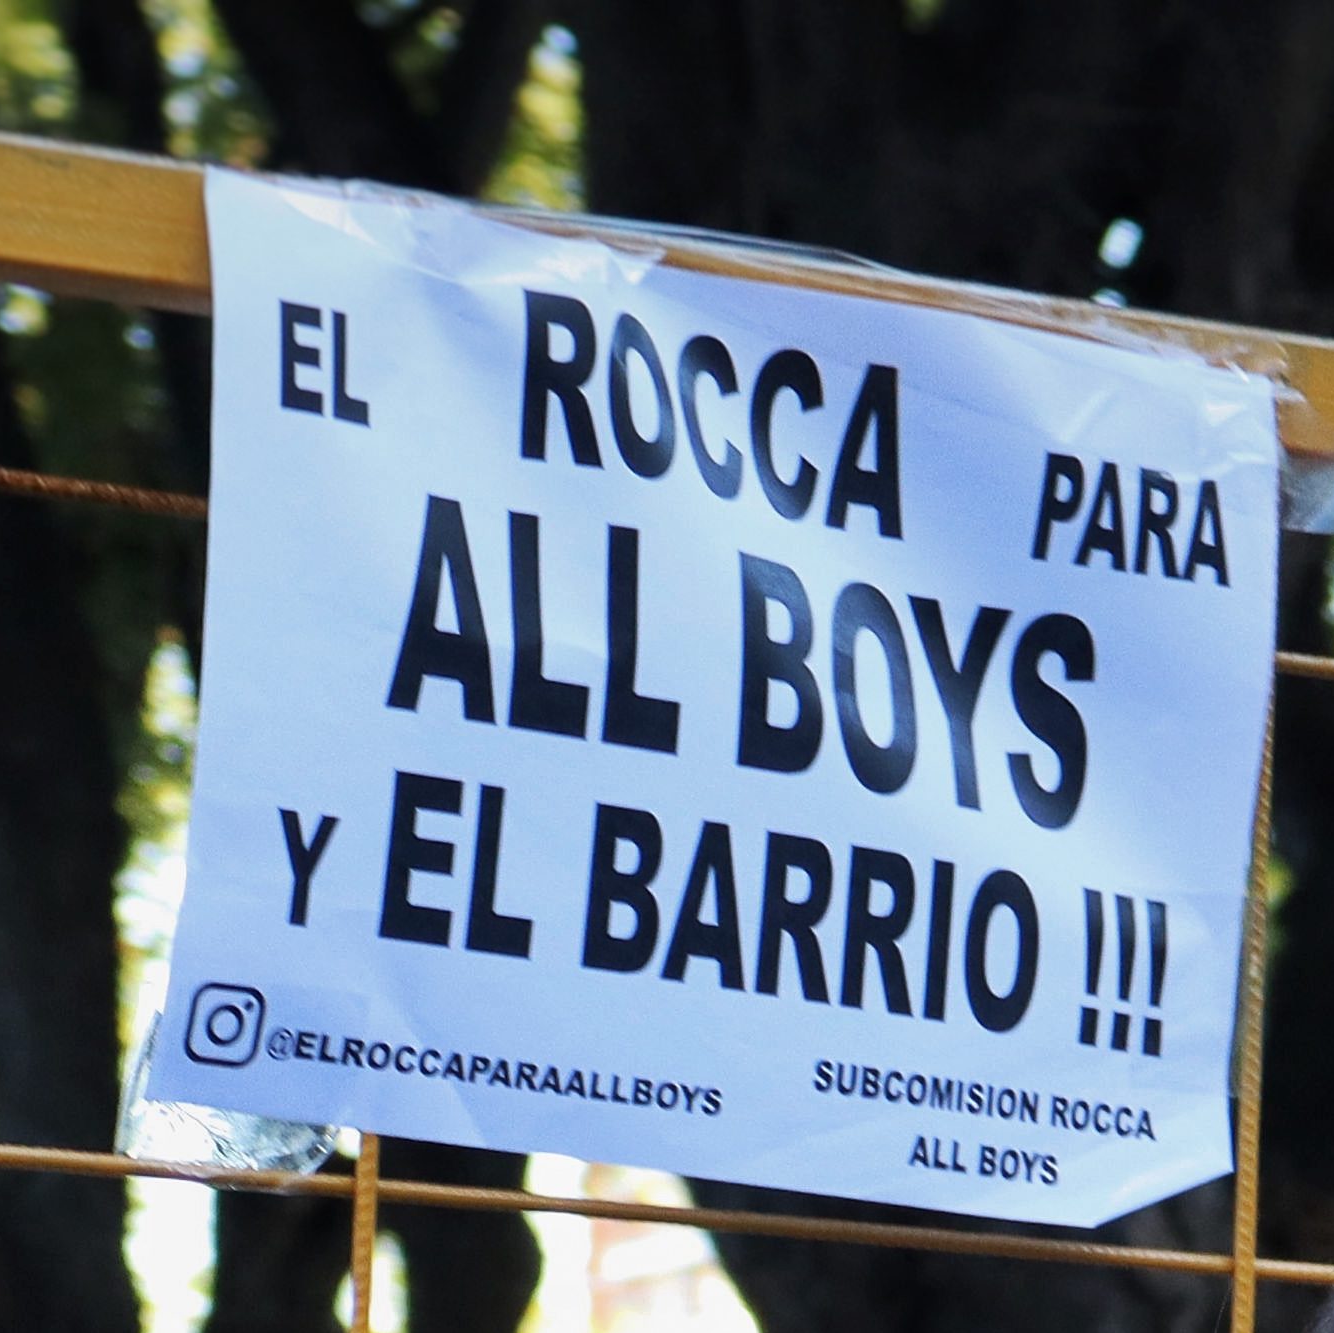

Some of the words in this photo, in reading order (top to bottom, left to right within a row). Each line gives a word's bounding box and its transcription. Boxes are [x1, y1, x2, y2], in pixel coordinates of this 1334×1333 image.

[279, 299, 371, 427] EL
[520, 288, 905, 541] ROCCA
[1029, 451, 1231, 588] PARA
[384, 493, 682, 757] ALL
[735, 550, 1097, 831] BOYS
[277, 807, 341, 929] Y
[376, 768, 535, 962] EL
[579, 801, 1041, 1035] BARRIO
[1077, 887, 1169, 1059] !!!
[265, 1026, 723, 1117] @ELROCCAPARAALLBOYS
[812, 1059, 1040, 1125] SUBCOMISION
[1050, 1096, 1157, 1142] ROCCA
[908, 1135, 968, 1175] ALL
[978, 1145, 1059, 1186] BOYS
